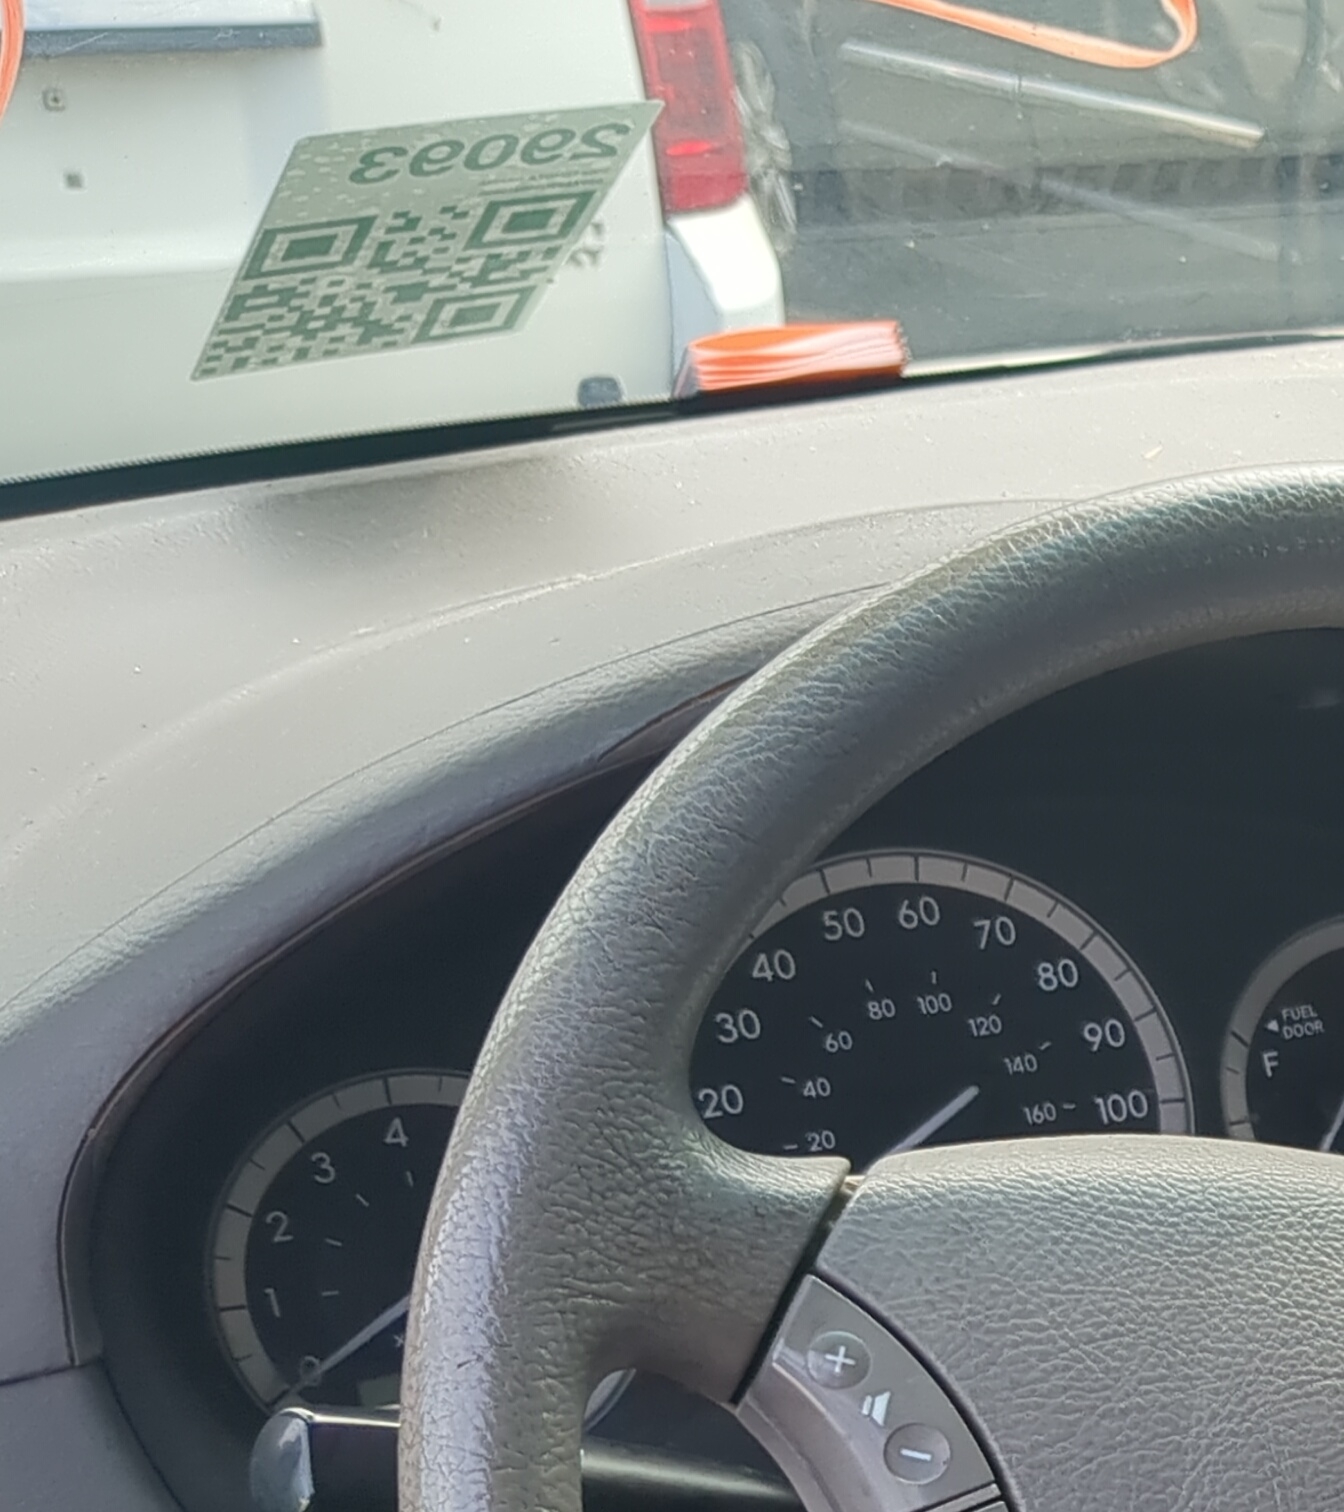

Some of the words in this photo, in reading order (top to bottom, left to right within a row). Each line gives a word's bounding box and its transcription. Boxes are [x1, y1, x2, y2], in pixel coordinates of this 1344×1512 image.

[822, 906, 866, 942] 50
[898, 895, 941, 930] 60
[973, 916, 1017, 951] 70
[751, 948, 797, 983] 40
[1037, 957, 1079, 992] 80
[867, 998, 897, 1021] 80
[916, 992, 953, 1017] 100
[1281, 1004, 1319, 1022] FUEL
[715, 1009, 762, 1045] 30
[967, 1013, 1002, 1039] 120
[1082, 1017, 1126, 1053] 90
[1282, 1019, 1325, 1041] DOOR
[824, 1031, 854, 1054] 60
[1003, 1053, 1039, 1077] 140
[1262, 1049, 1279, 1078] F
[698, 1083, 744, 1120] 20
[802, 1077, 832, 1100] 40
[1023, 1102, 1058, 1126] 160
[1096, 1088, 1149, 1126] 100
[383, 1116, 410, 1148] 4
[805, 1129, 837, 1153] 20
[310, 1151, 337, 1185] 3
[265, 1210, 294, 1243] 2
[263, 1287, 282, 1318] 1
